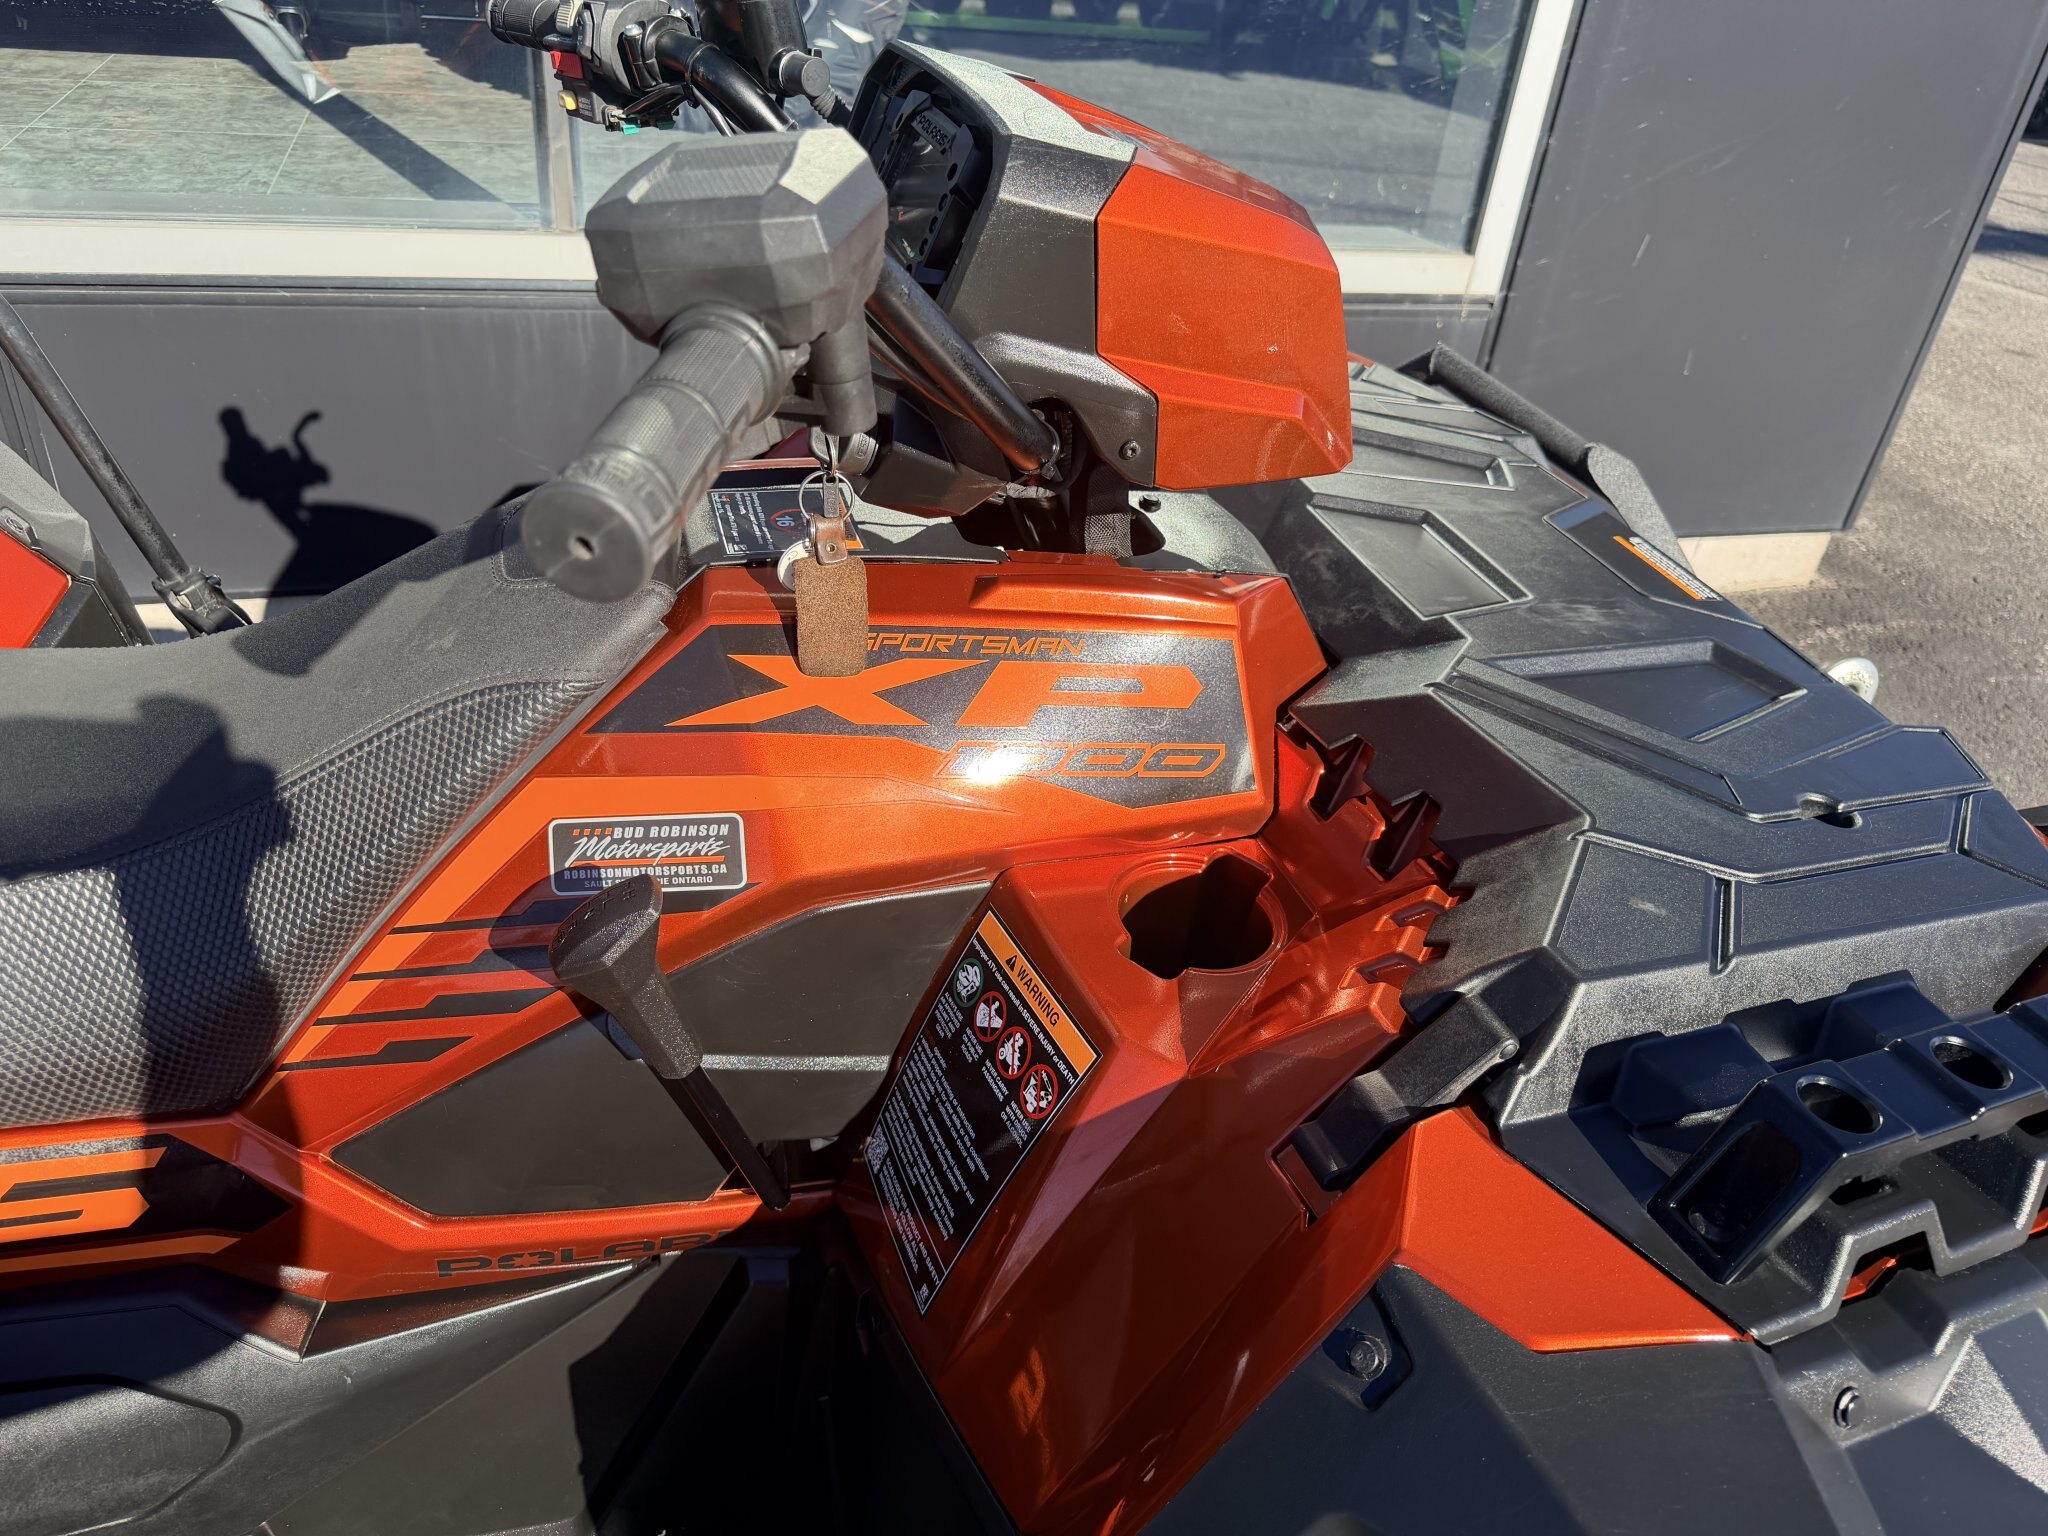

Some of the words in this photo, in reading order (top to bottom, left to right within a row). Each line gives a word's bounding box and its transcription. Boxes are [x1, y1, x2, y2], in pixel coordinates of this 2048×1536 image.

[774, 515, 796, 526] 16
[664, 654, 1203, 727] XP
[613, 826, 644, 839] BUD
[650, 824, 729, 838] ROBINSON
[564, 836, 731, 867] Motorsports
[564, 863, 727, 880] ROBINSONMOTORSPORTS.CA
[584, 879, 613, 888] SAULT
[672, 875, 713, 885] ONTARIO
[945, 991, 957, 1011] ALWAYS
[972, 938, 989, 962] Improper
[988, 959, 997, 972] ATV
[1008, 989, 1020, 1006] result
[1019, 1004, 1024, 1012] in
[1022, 1009, 1039, 1034] SEVERE
[1038, 1032, 1055, 1056] INJURY
[1058, 1061, 1074, 1084] DEATH
[1017, 966, 1061, 1026] WARNING
[935, 1009, 952, 1039] PROTECTIVE
[945, 1002, 960, 1028] APPROVED
[961, 1043, 972, 1063] ROADS
[963, 1033, 968, 1043] ON
[967, 1041, 979, 1060] PUBLIC
[966, 1026, 977, 1045] NEVER
[982, 1065, 1004, 1102] PASSENGERS
[986, 1058, 997, 1078] NEVER
[996, 1075, 1008, 1096] CARRY
[931, 1057, 942, 1078] proper
[941, 1075, 954, 1100] training
[953, 1098, 958, 1106] or
[957, 1103, 976, 1139] instruction
[1001, 1111, 1007, 1121] OR
[1006, 1105, 1015, 1120] WITH
[1014, 1119, 1027, 1140] DRUGS
[1011, 1100, 1023, 1120] NEVER
[1023, 1119, 1031, 1132] USE
[938, 1101, 952, 1128] collision
[957, 1138, 967, 1157] occur
[967, 1155, 975, 1172] with
[945, 1100, 953, 1115] your
[952, 1112, 961, 1129] skills
[960, 1127, 965, 1136] or
[970, 1144, 990, 1181] conditions
[928, 1114, 945, 1150] passengers
[945, 1147, 955, 1167] affect
[954, 1164, 967, 1191] balance
[966, 1188, 974, 1204] and
[934, 1141, 939, 1150] of
[937, 1148, 948, 1170] losing
[947, 1167, 959, 1192] control
[914, 1164, 928, 1197] pavement
[933, 1208, 949, 1242] seriously
[925, 1173, 936, 1196] terrain
[941, 1206, 946, 1215] in
[944, 1214, 954, 1234] turns
[930, 1167, 935, 1177] to
[934, 1174, 943, 1194] avoid
[942, 1191, 955, 1218] vehicle
[893, 1174, 902, 1195] CODE
[906, 1206, 921, 1243] PRODUCT
[926, 1255, 940, 1286] SAFETY
[900, 1209, 913, 1241] FOLLOW
[437, 1228, 735, 1277] POLAR
